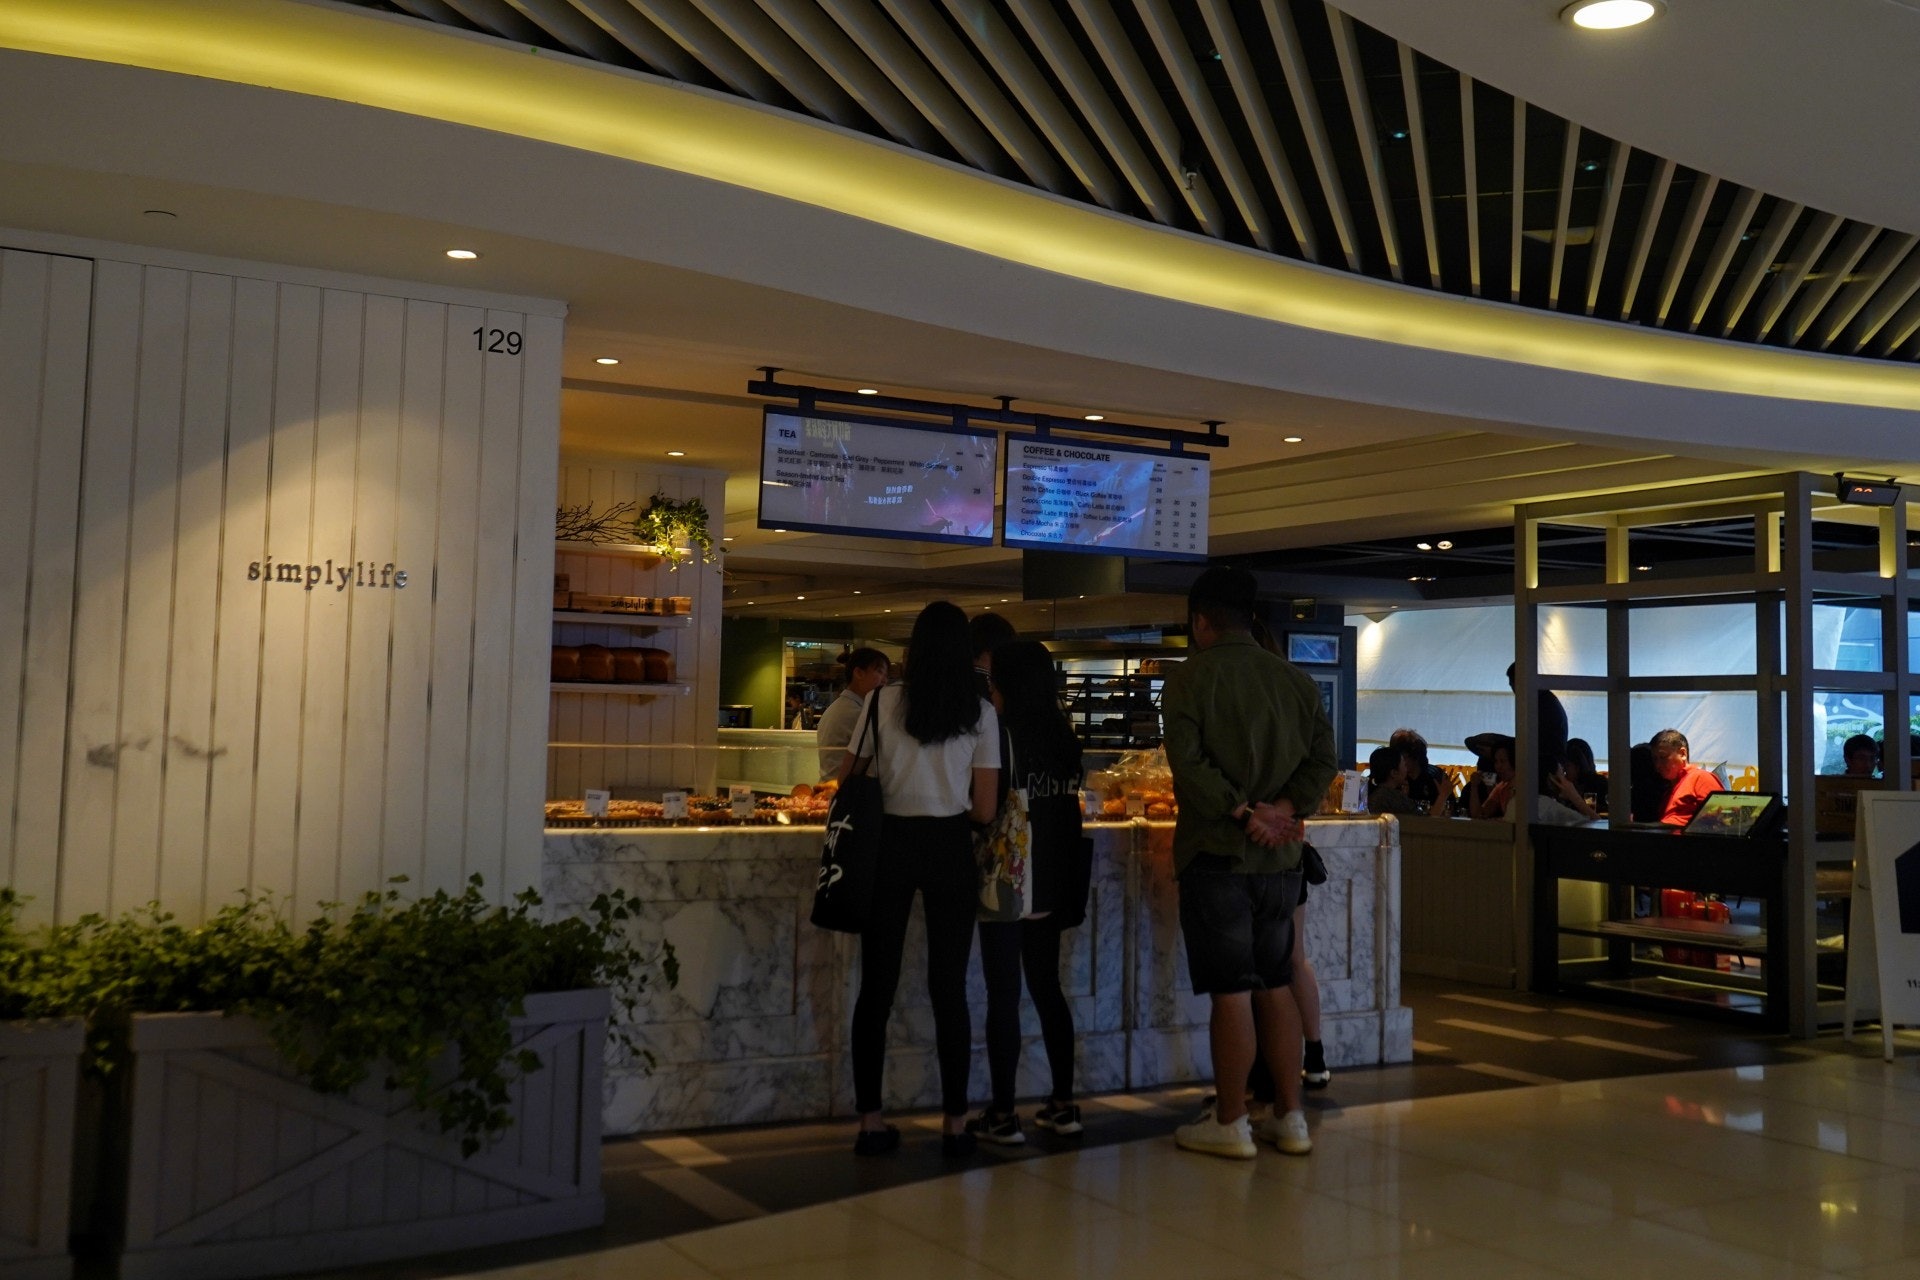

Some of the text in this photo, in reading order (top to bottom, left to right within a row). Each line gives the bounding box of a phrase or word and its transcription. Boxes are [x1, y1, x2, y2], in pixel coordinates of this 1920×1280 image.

[473, 326, 523, 355] 129
[779, 428, 797, 439] TEA
[777, 447, 806, 456] Breakfast
[855, 455, 869, 463] Grey
[873, 457, 905, 466] Peppermint
[1023, 445, 1055, 456] COFFEE
[1056, 449, 1062, 457] &
[1064, 450, 1111, 462] CHOCOLATE
[1022, 474, 1041, 482] Double
[1042, 476, 1065, 485] Espresso
[1038, 486, 1055, 494] Coffee
[1044, 509, 1057, 517] Latte
[247, 555, 408, 592] simplylife
